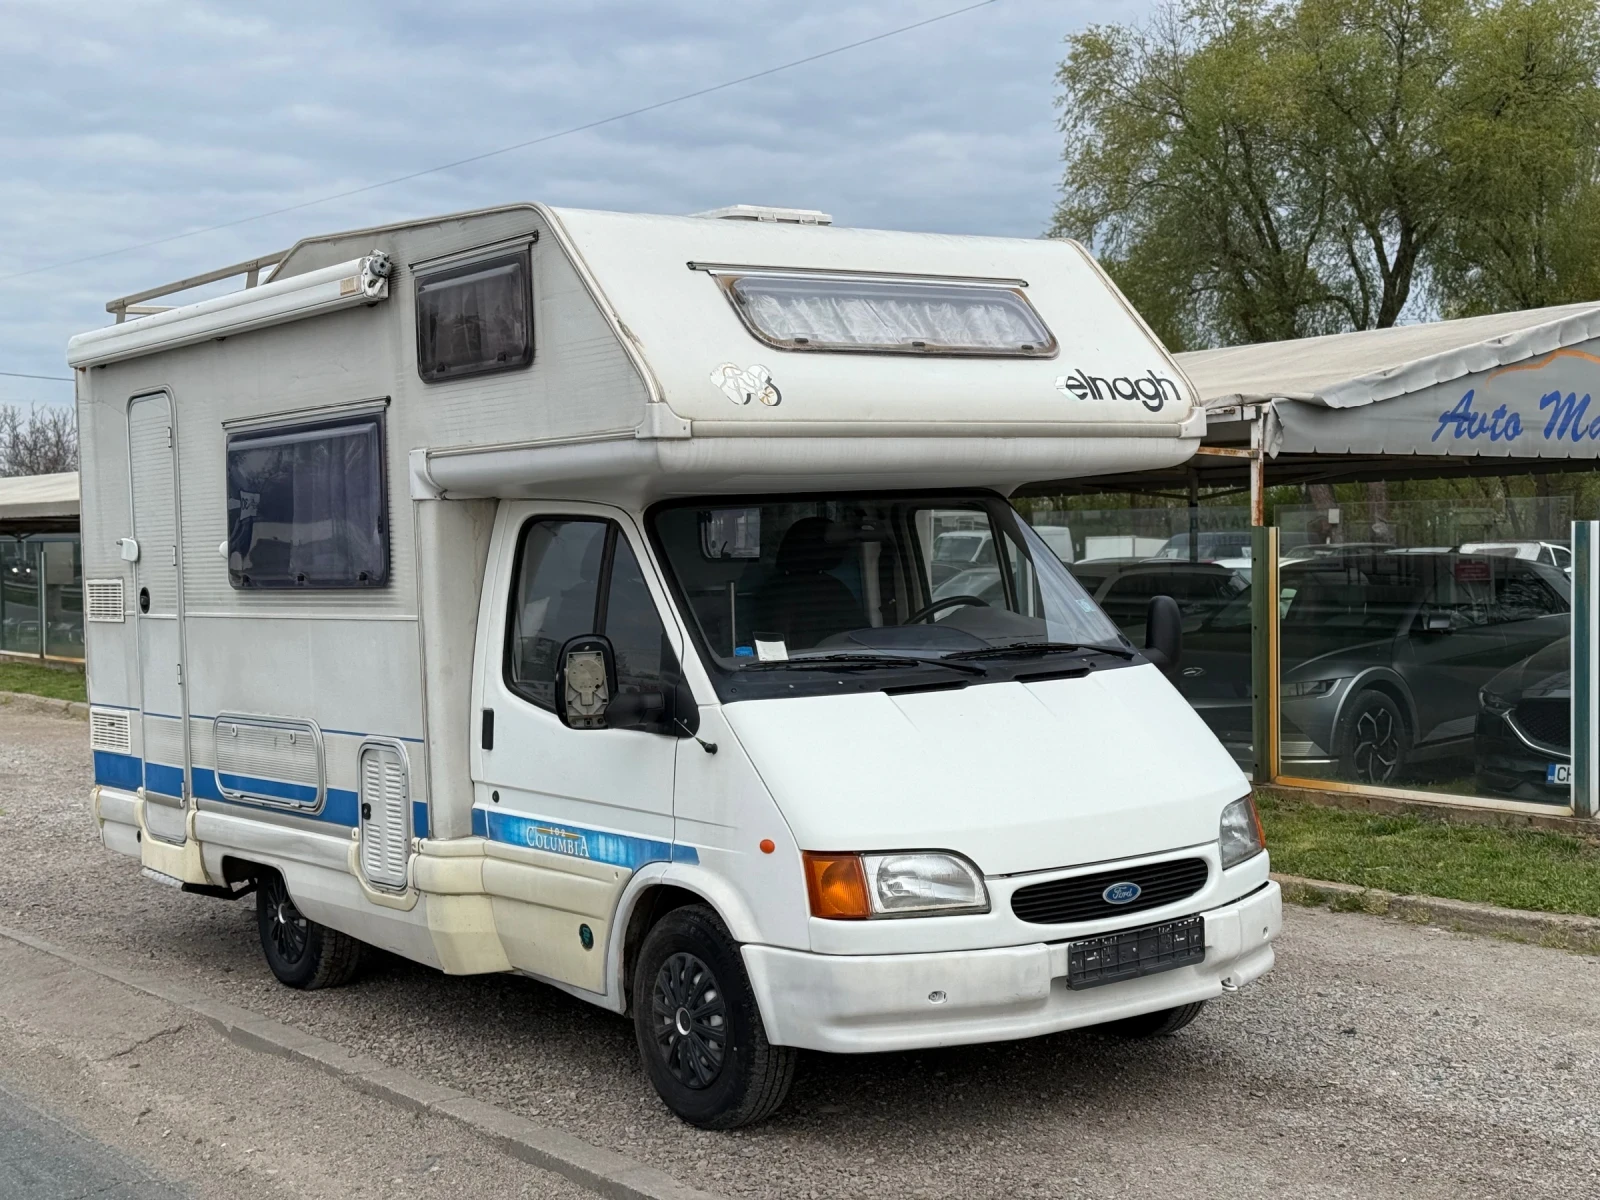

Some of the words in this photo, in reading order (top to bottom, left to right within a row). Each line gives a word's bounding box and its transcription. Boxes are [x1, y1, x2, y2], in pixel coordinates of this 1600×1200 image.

[1066, 369, 1181, 412] elnagh
[1431, 389, 1524, 442] Auto
[1112, 885, 1133, 900] Ford
